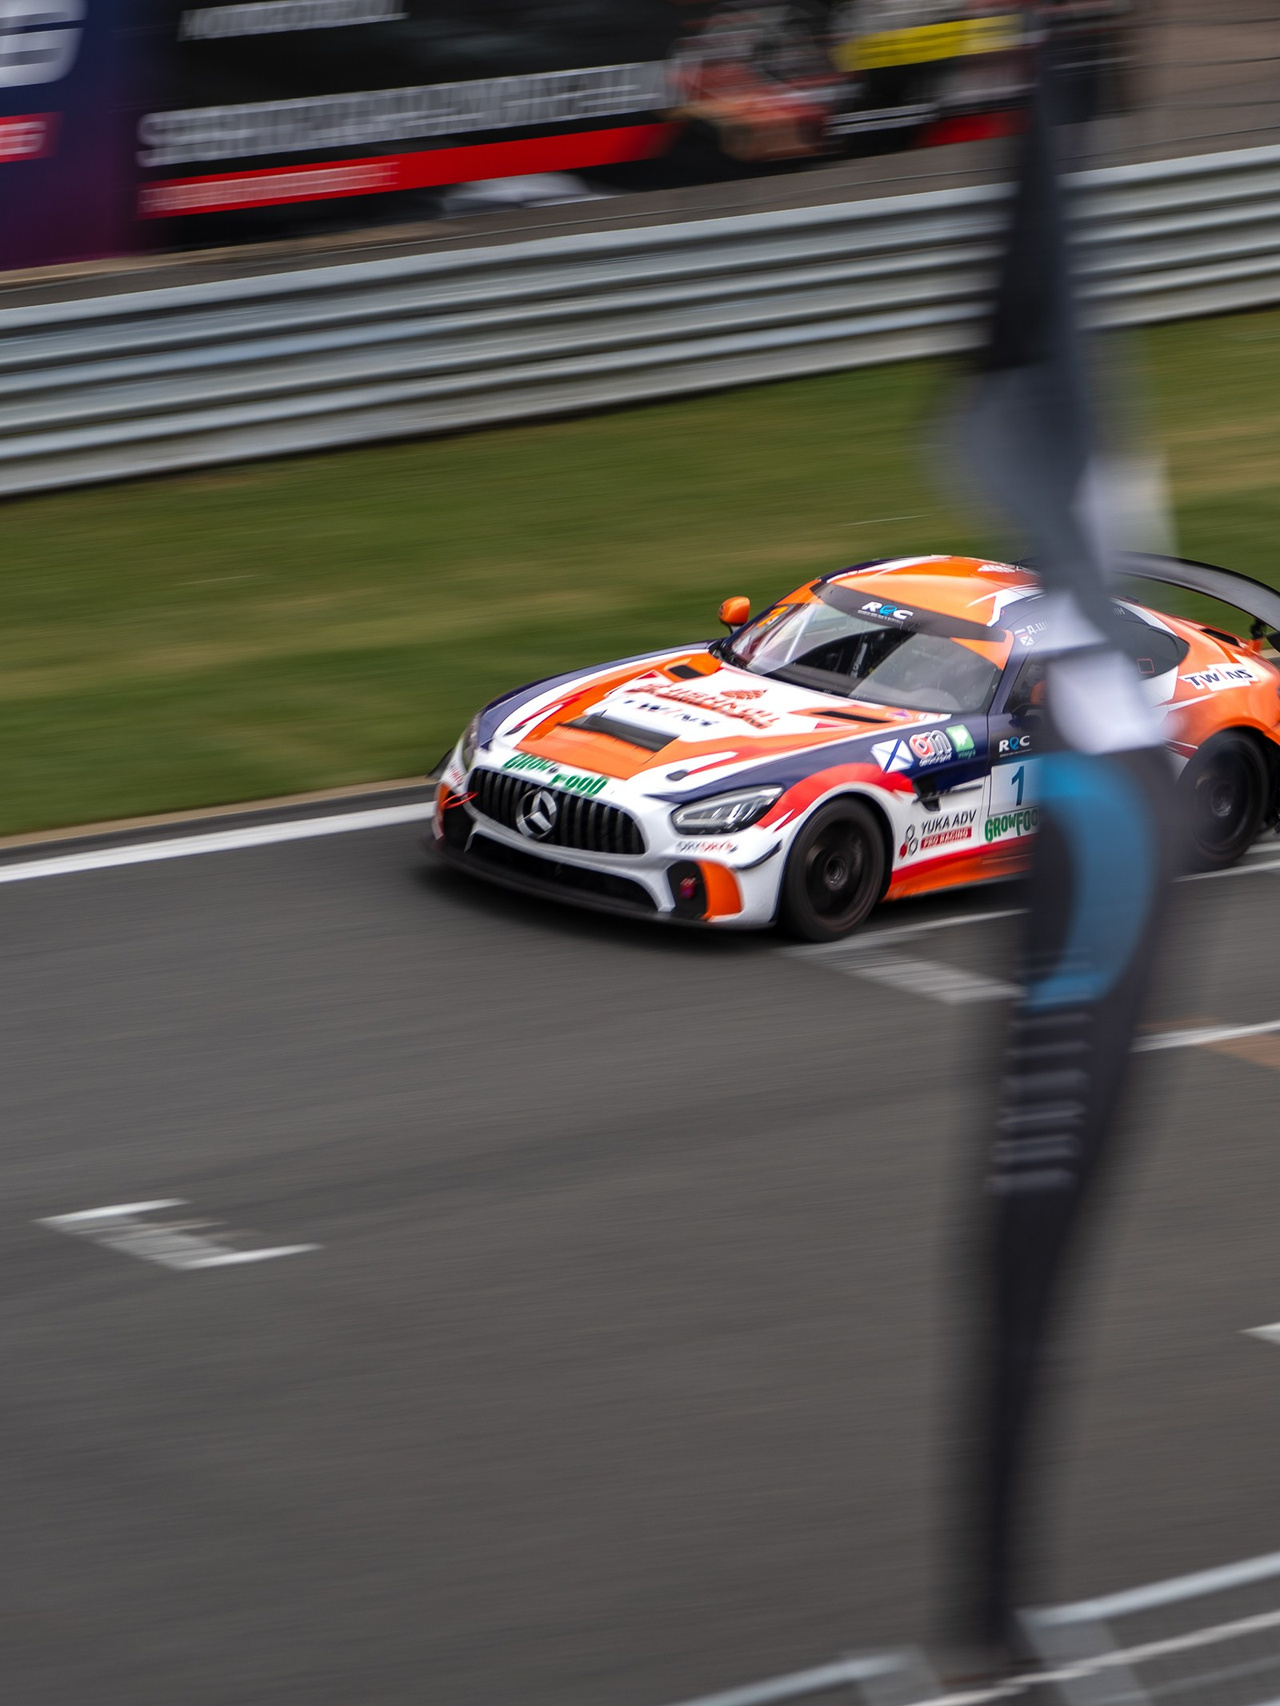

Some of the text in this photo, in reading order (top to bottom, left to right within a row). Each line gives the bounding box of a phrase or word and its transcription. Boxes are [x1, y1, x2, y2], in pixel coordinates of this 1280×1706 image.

[1184, 668, 1253, 686] TWINS
[1011, 765, 1025, 806] 1
[921, 809, 977, 836] YUKA ADV
[984, 808, 1041, 842] GROWFOO
[923, 828, 969, 849] PRO RACING
